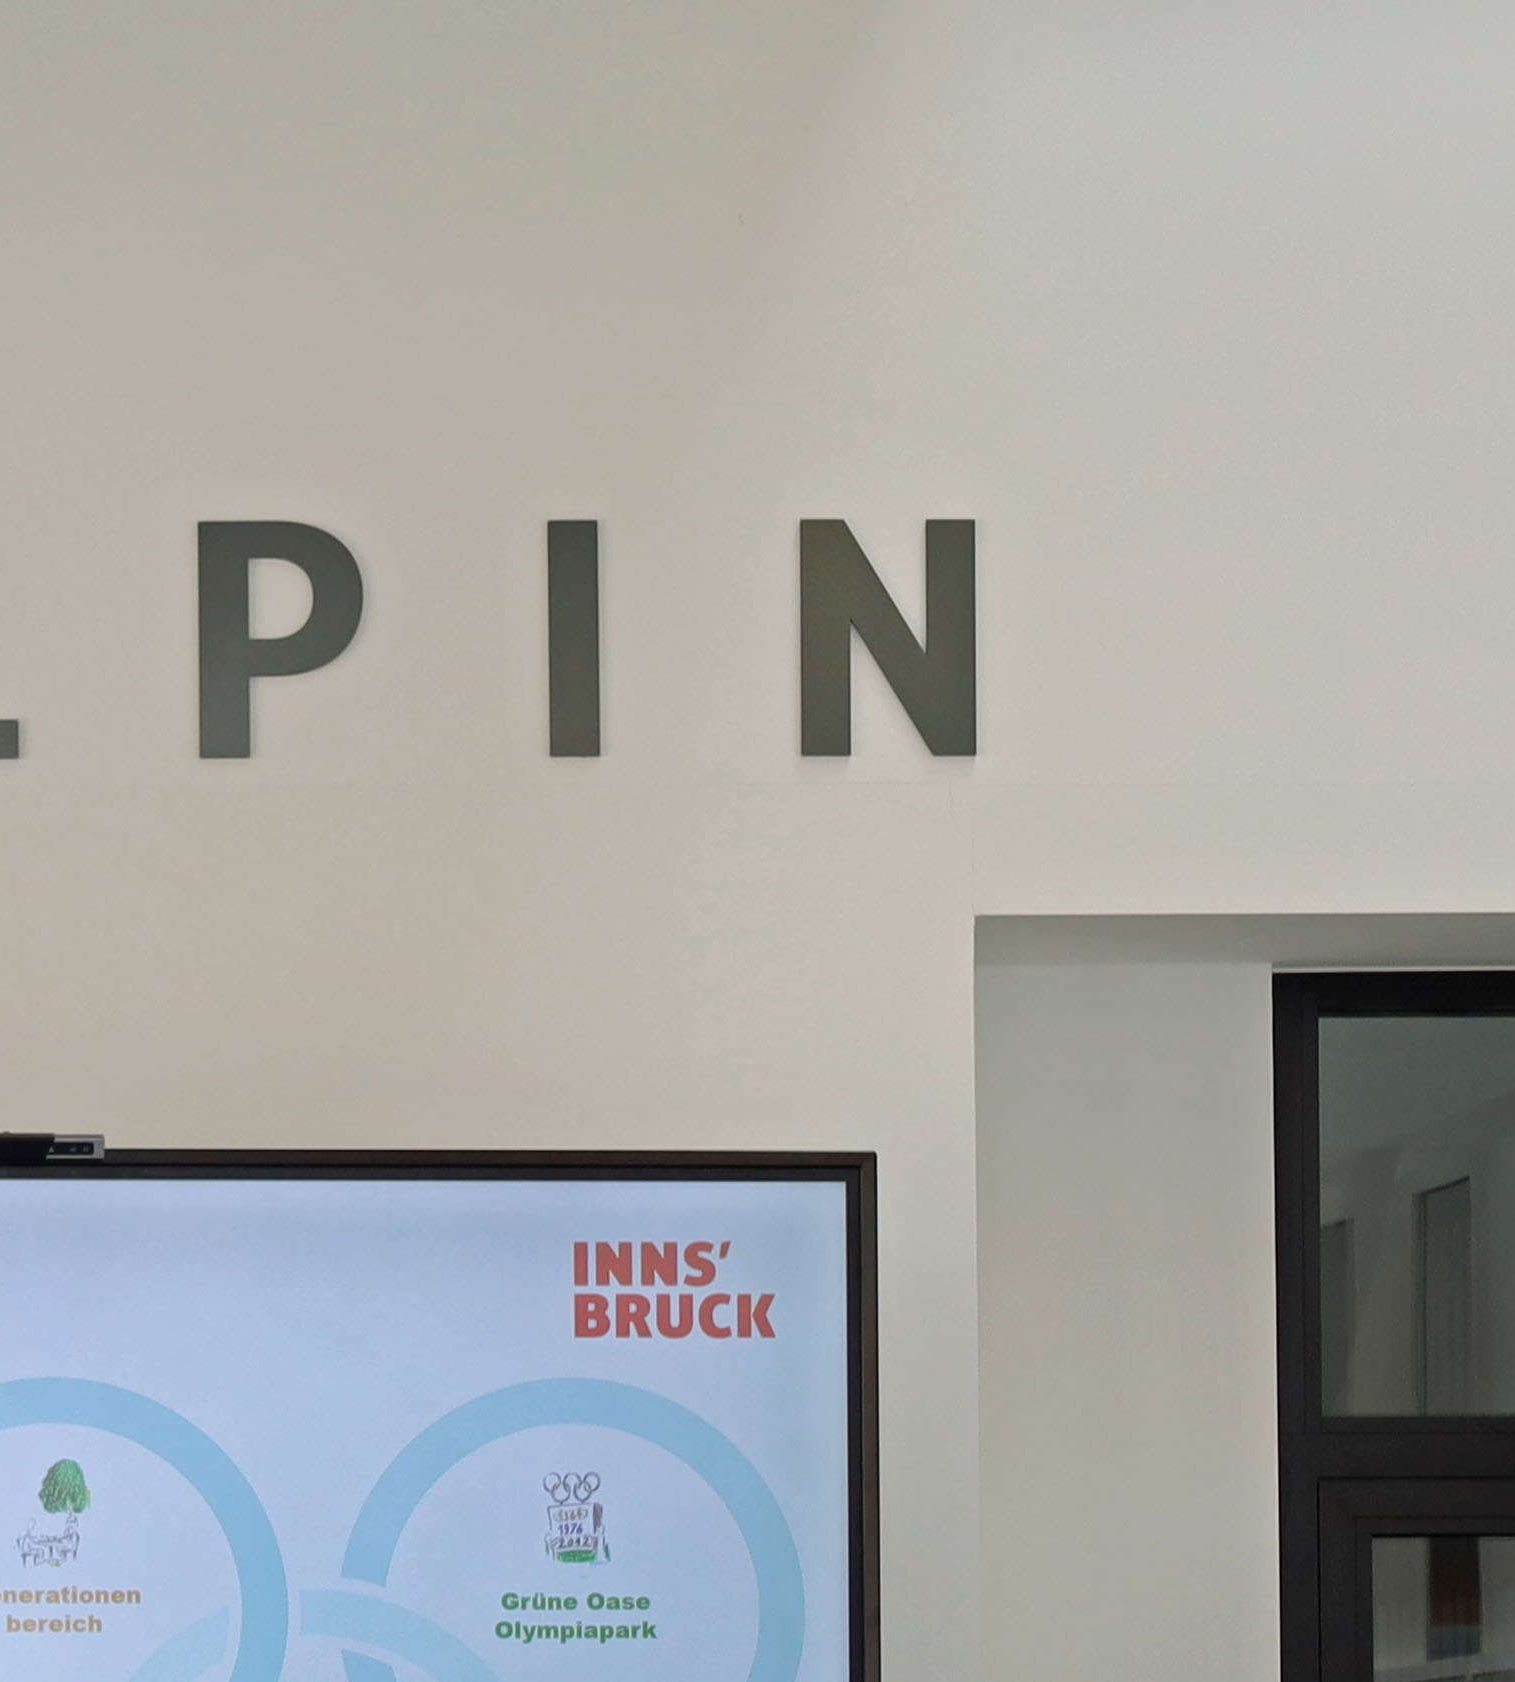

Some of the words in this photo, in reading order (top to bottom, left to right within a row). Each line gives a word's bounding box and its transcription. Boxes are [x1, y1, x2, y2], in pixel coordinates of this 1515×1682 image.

[573, 1293, 777, 1339] BRUCK
[500, 1591, 578, 1611] Grüne
[586, 1591, 651, 1611] Oase
[5, 1613, 103, 1633] bereich
[494, 1620, 658, 1644] Olympiapark
